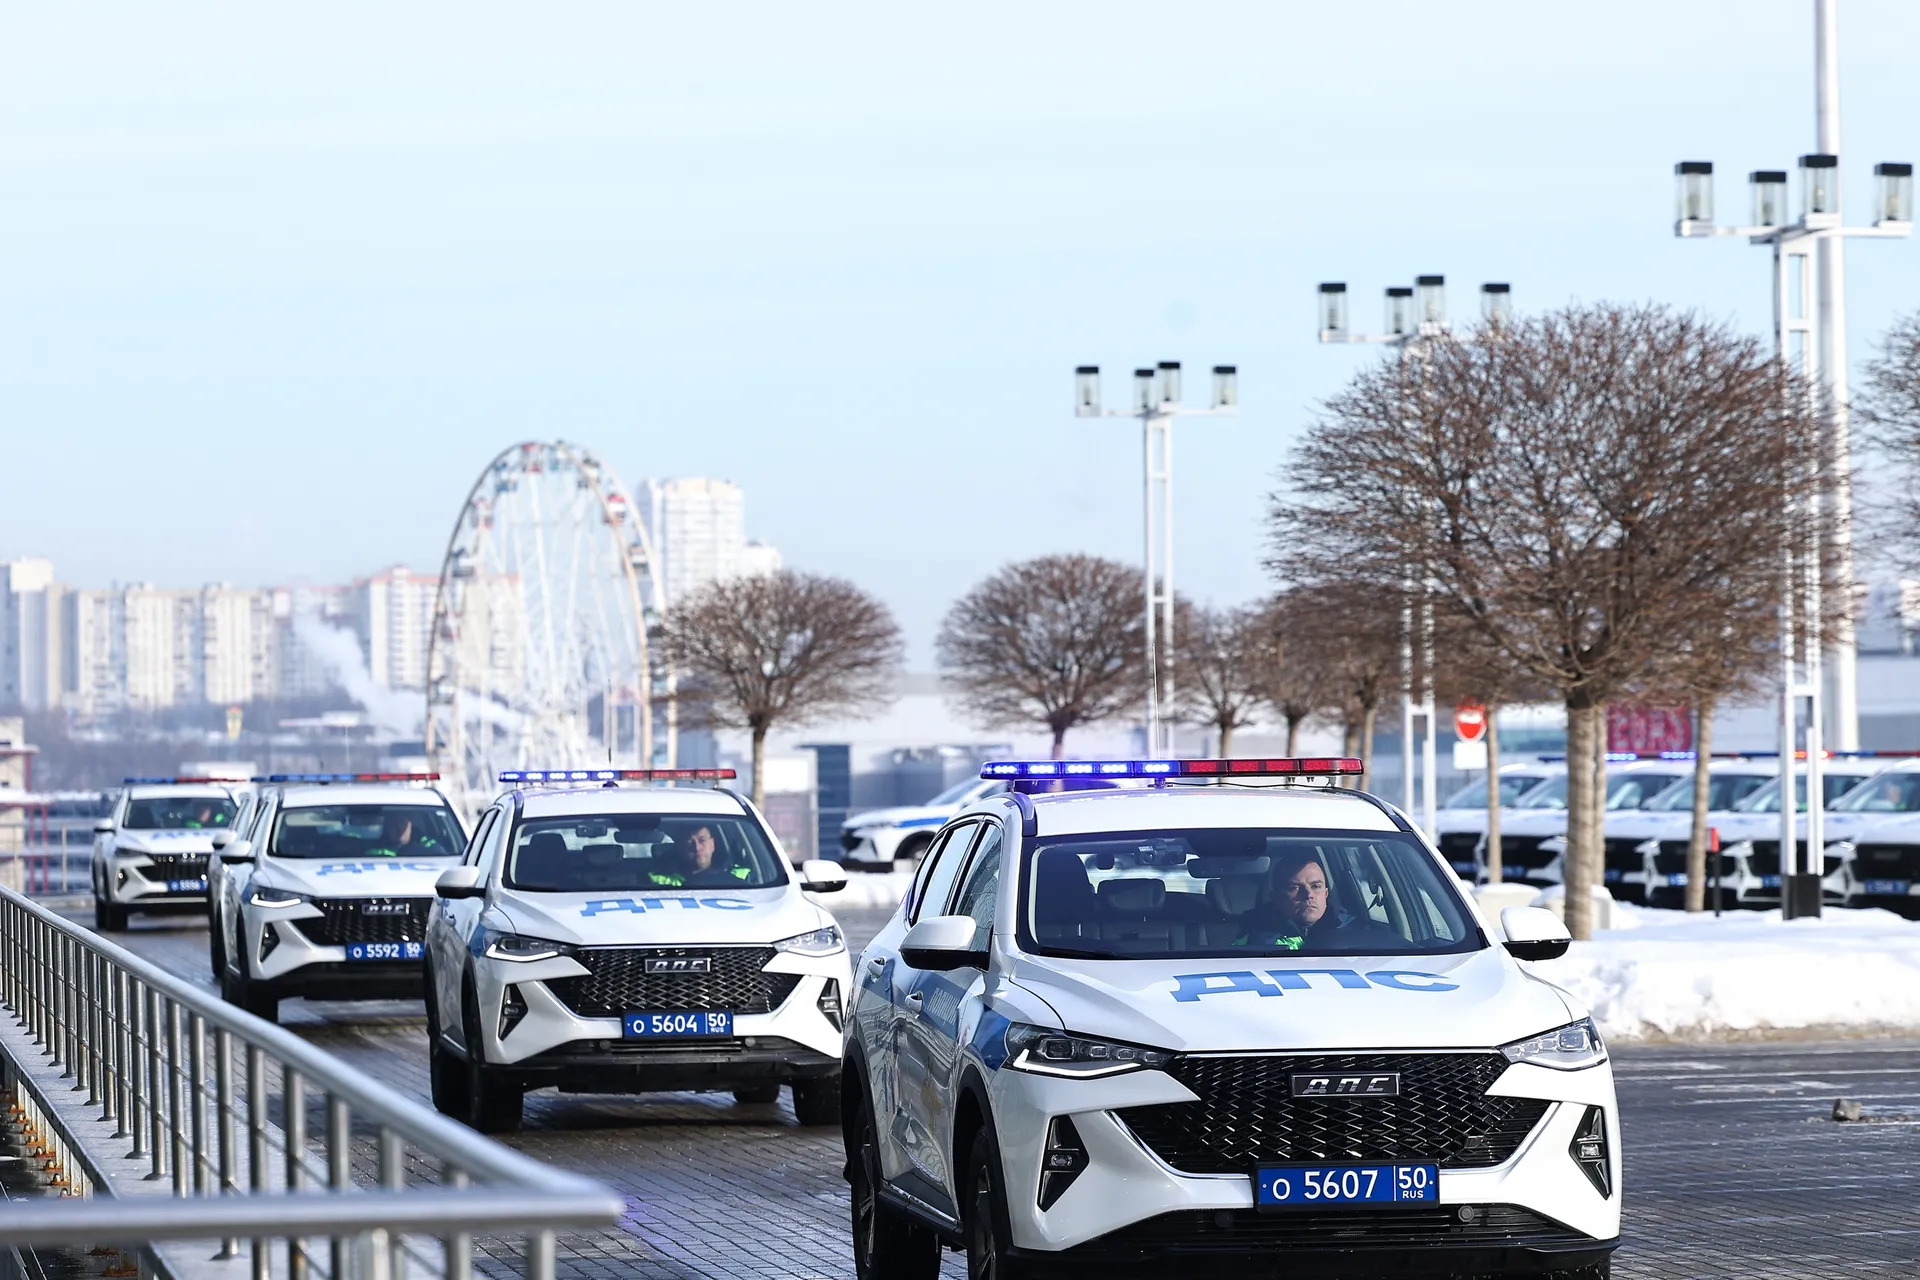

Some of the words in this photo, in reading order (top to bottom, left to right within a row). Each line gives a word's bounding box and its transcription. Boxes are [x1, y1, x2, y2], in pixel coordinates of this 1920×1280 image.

[316, 863, 440, 876] ДПС
[579, 898, 754, 917] ДПС
[366, 943, 400, 958] 5592
[406, 942, 421, 954] 50
[1169, 969, 1461, 1003] ДПС
[651, 1014, 698, 1033] 5604
[708, 1013, 727, 1027] 50
[1302, 1077, 1390, 1095] ДПС
[1304, 1169, 1379, 1200] 5607
[1398, 1167, 1427, 1189] 50
[1402, 1190, 1425, 1199] RUS
